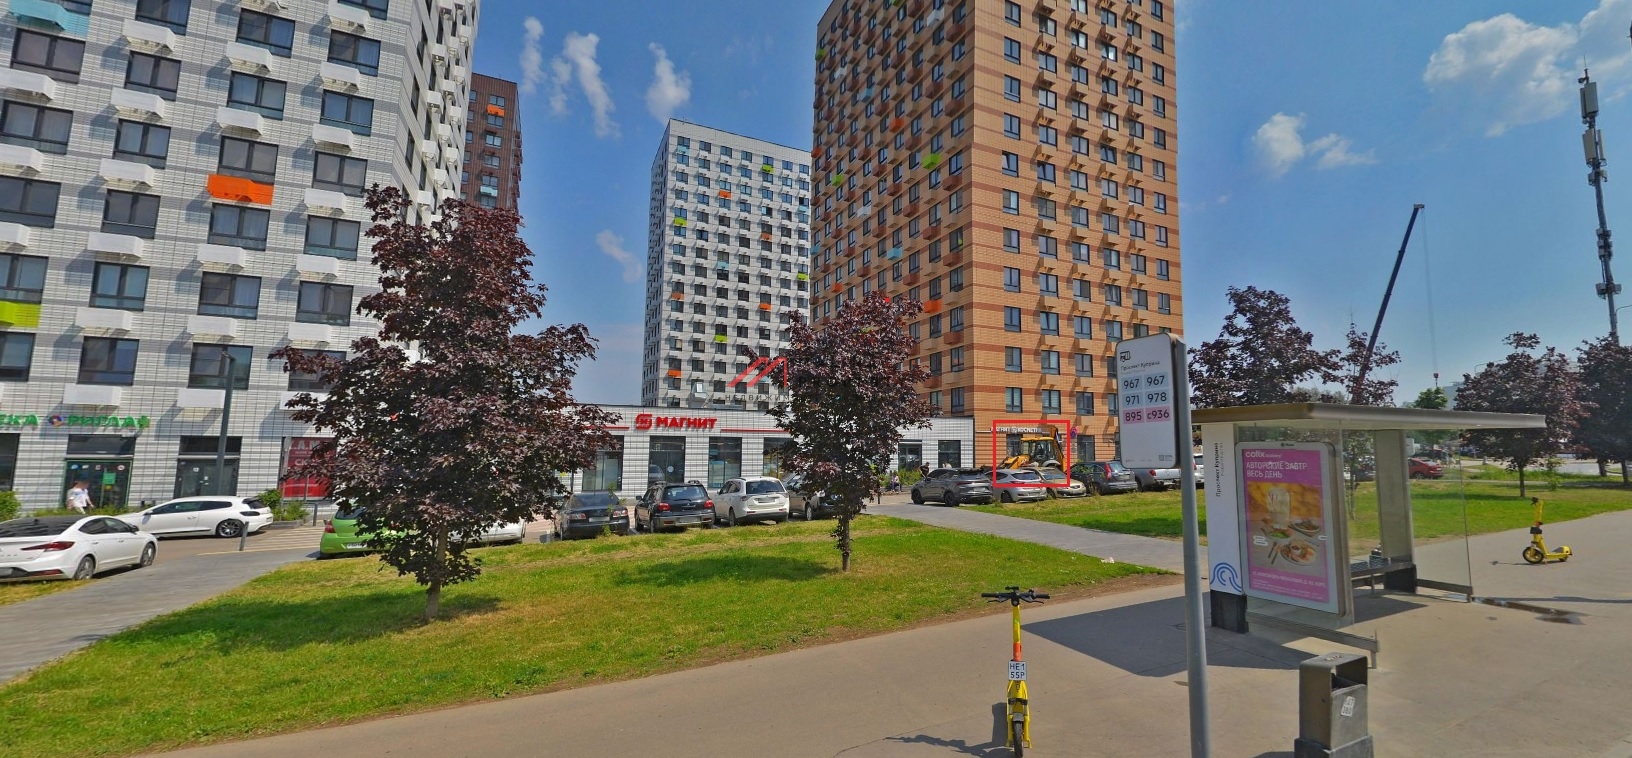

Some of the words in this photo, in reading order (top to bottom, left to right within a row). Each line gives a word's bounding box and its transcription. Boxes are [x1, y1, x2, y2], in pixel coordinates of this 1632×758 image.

[1123, 379, 1140, 390] 967
[1146, 375, 1165, 387] 967
[1125, 395, 1140, 406] 971
[1147, 392, 1167, 403] 978
[1125, 411, 1142, 422] 895
[656, 416, 718, 430] МАГНИТ
[1246, 461, 1284, 470] АВТОРСКИЕ
[1246, 470, 1264, 478] ВЕСЬ
[1264, 470, 1283, 479] ДЕНЬ
